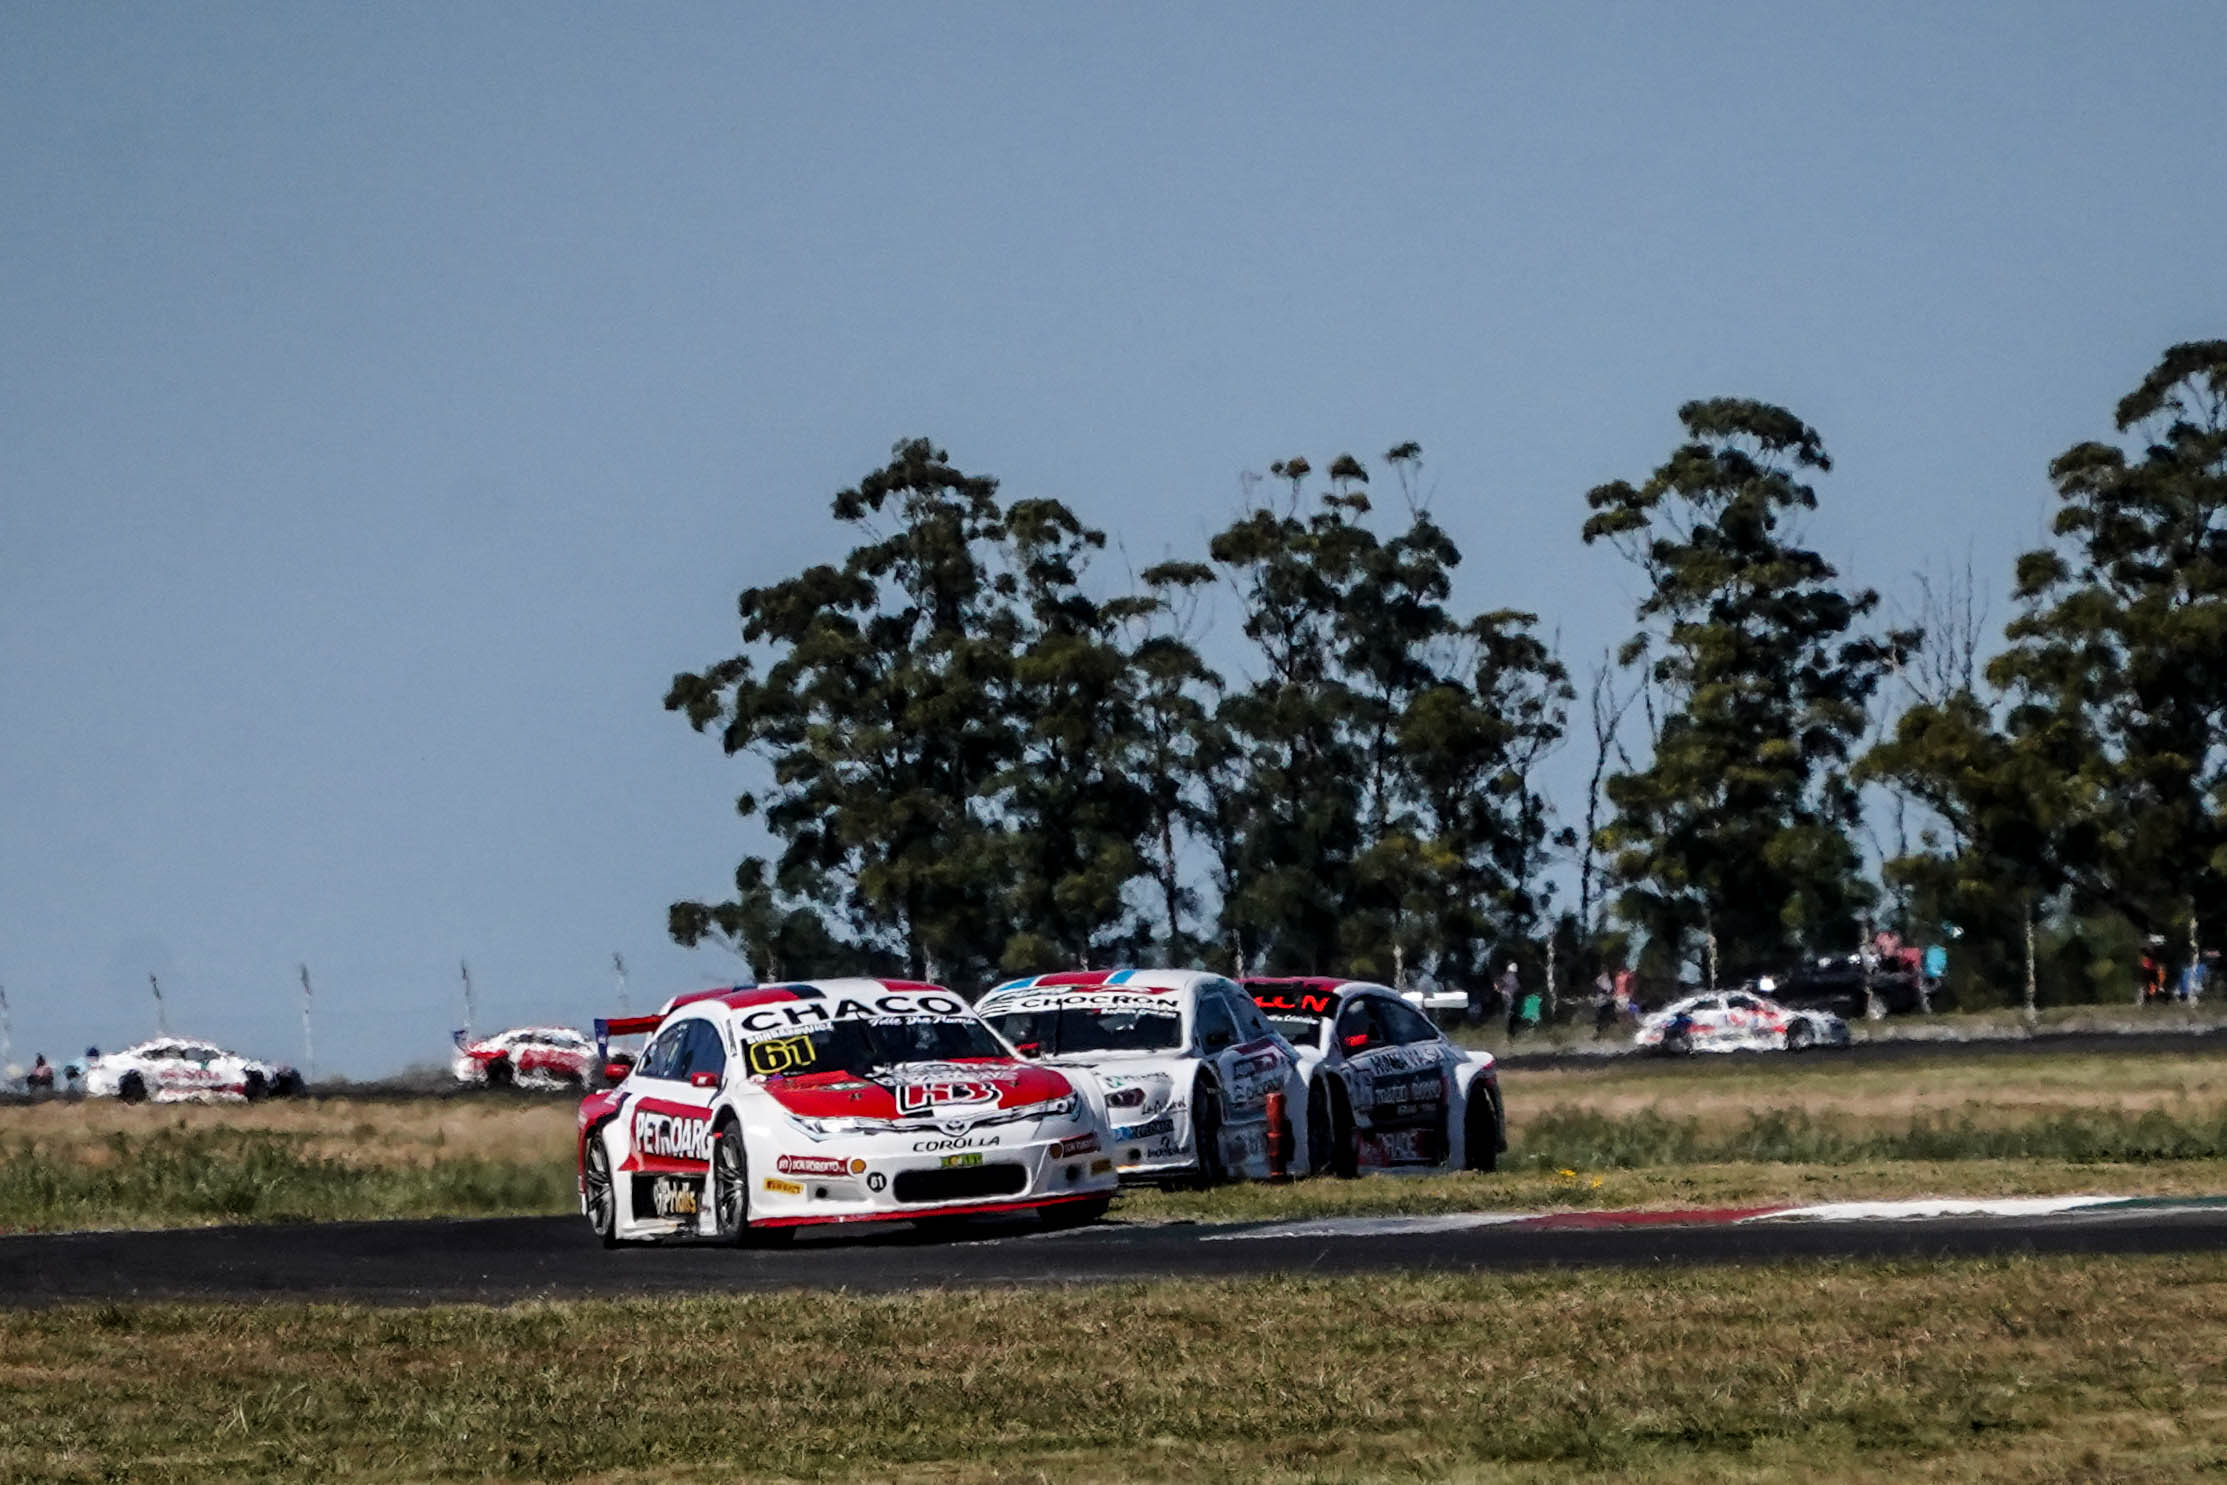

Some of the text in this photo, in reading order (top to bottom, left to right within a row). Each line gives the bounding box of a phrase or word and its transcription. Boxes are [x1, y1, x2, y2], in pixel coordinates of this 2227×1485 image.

[741, 996, 962, 1032] CHACO
[1021, 995, 1179, 1008] CHOCRON
[750, 1035, 817, 1075] 61
[913, 1135, 1000, 1153] COROLLA
